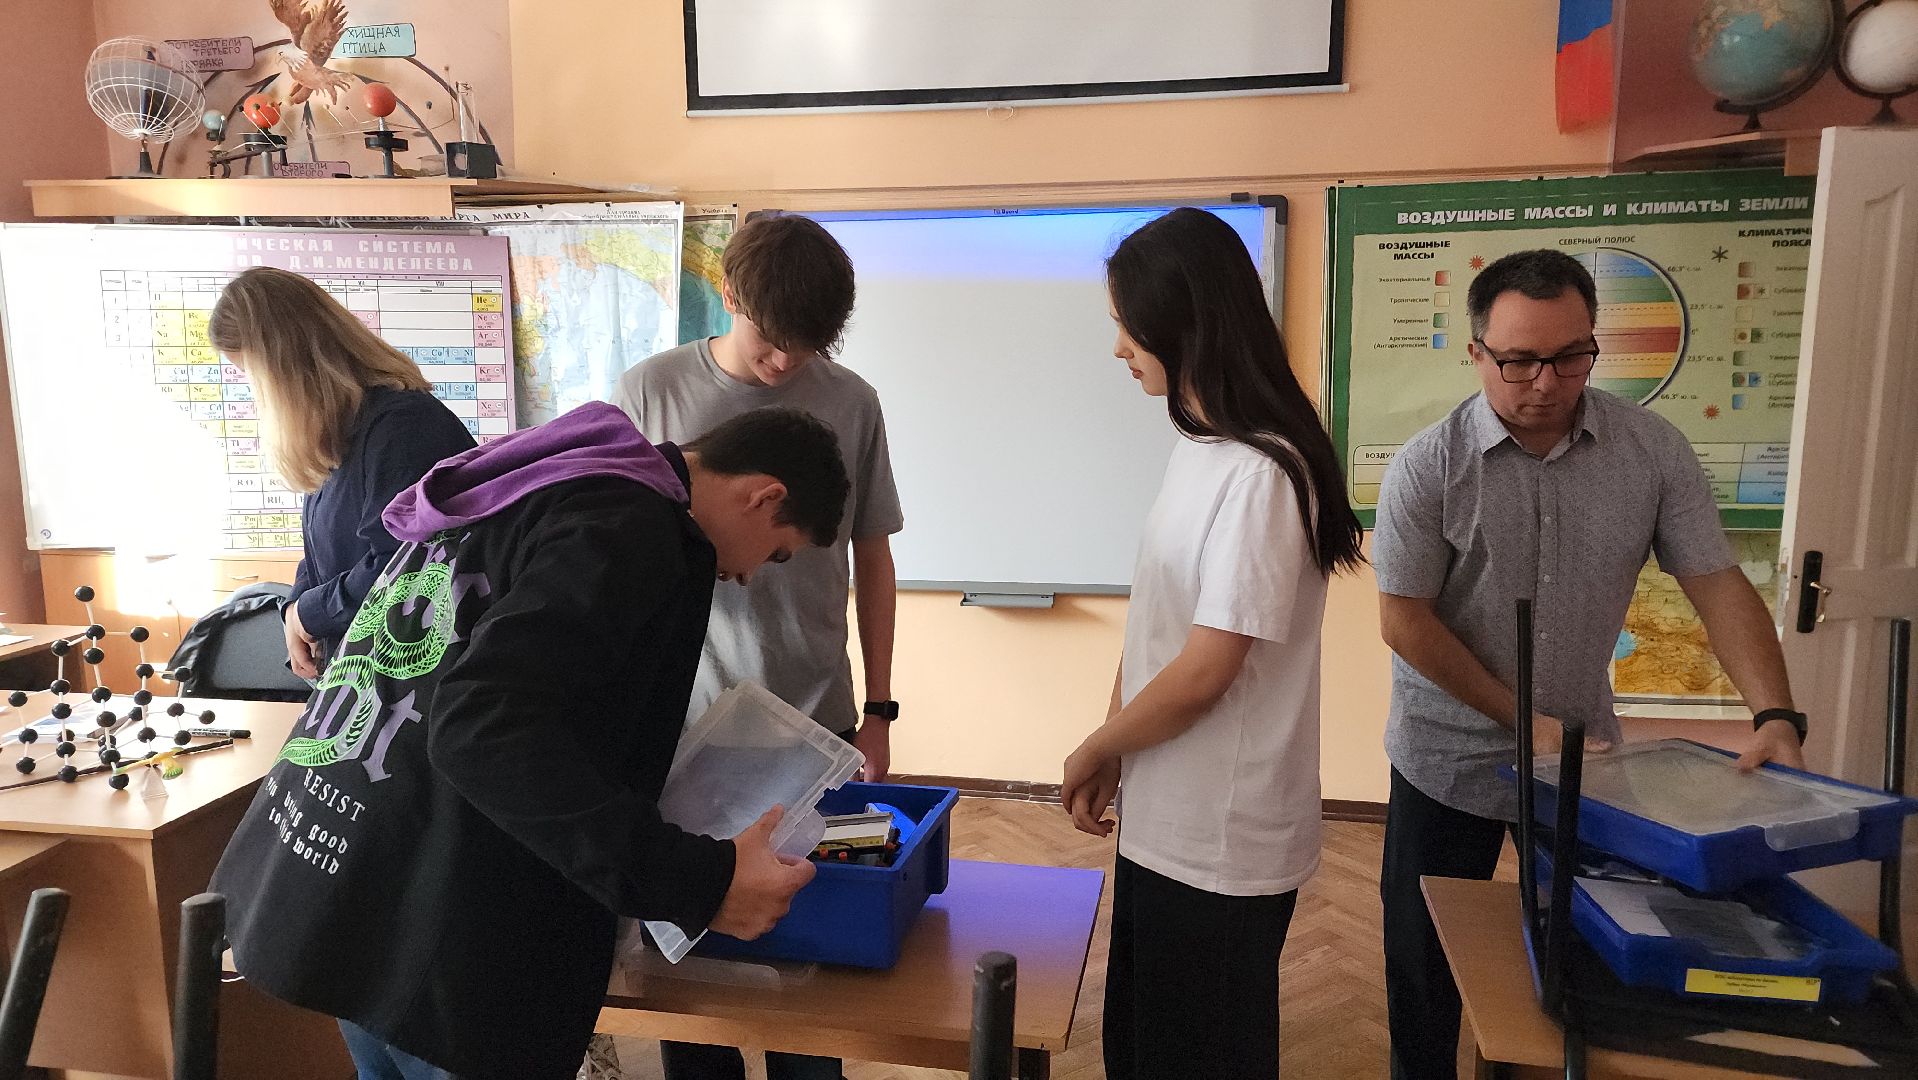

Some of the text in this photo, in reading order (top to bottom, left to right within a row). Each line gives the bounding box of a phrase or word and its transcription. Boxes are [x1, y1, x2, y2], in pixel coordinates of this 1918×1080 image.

[346, 26, 401, 39] ХИЩНАЯ
[193, 46, 241, 57] ТРЕТЬЕГО
[342, 41, 387, 55] ПТИЦА
[492, 211, 531, 221] МИРА
[1397, 196, 1809, 226] ВОЗДУШНЫЕ МАССЫ И КЛИМАТЫ ЗЕМЛИ
[1378, 240, 1451, 250] ВОЗДУШНЫЕ
[1558, 235, 1636, 245] СЕВЕРНЫЙ ПОЛЮС
[358, 240, 457, 254] СИСТЕМА
[1393, 252, 1435, 260] МАССЫ
[476, 296, 488, 304] He
[190, 348, 202, 356] Ca
[207, 366, 219, 375] Zn
[224, 366, 237, 375] Ga
[479, 366, 490, 375] Kr
[303, 768, 366, 822] RESIST
[307, 823, 349, 855] good
[292, 835, 340, 875] world
